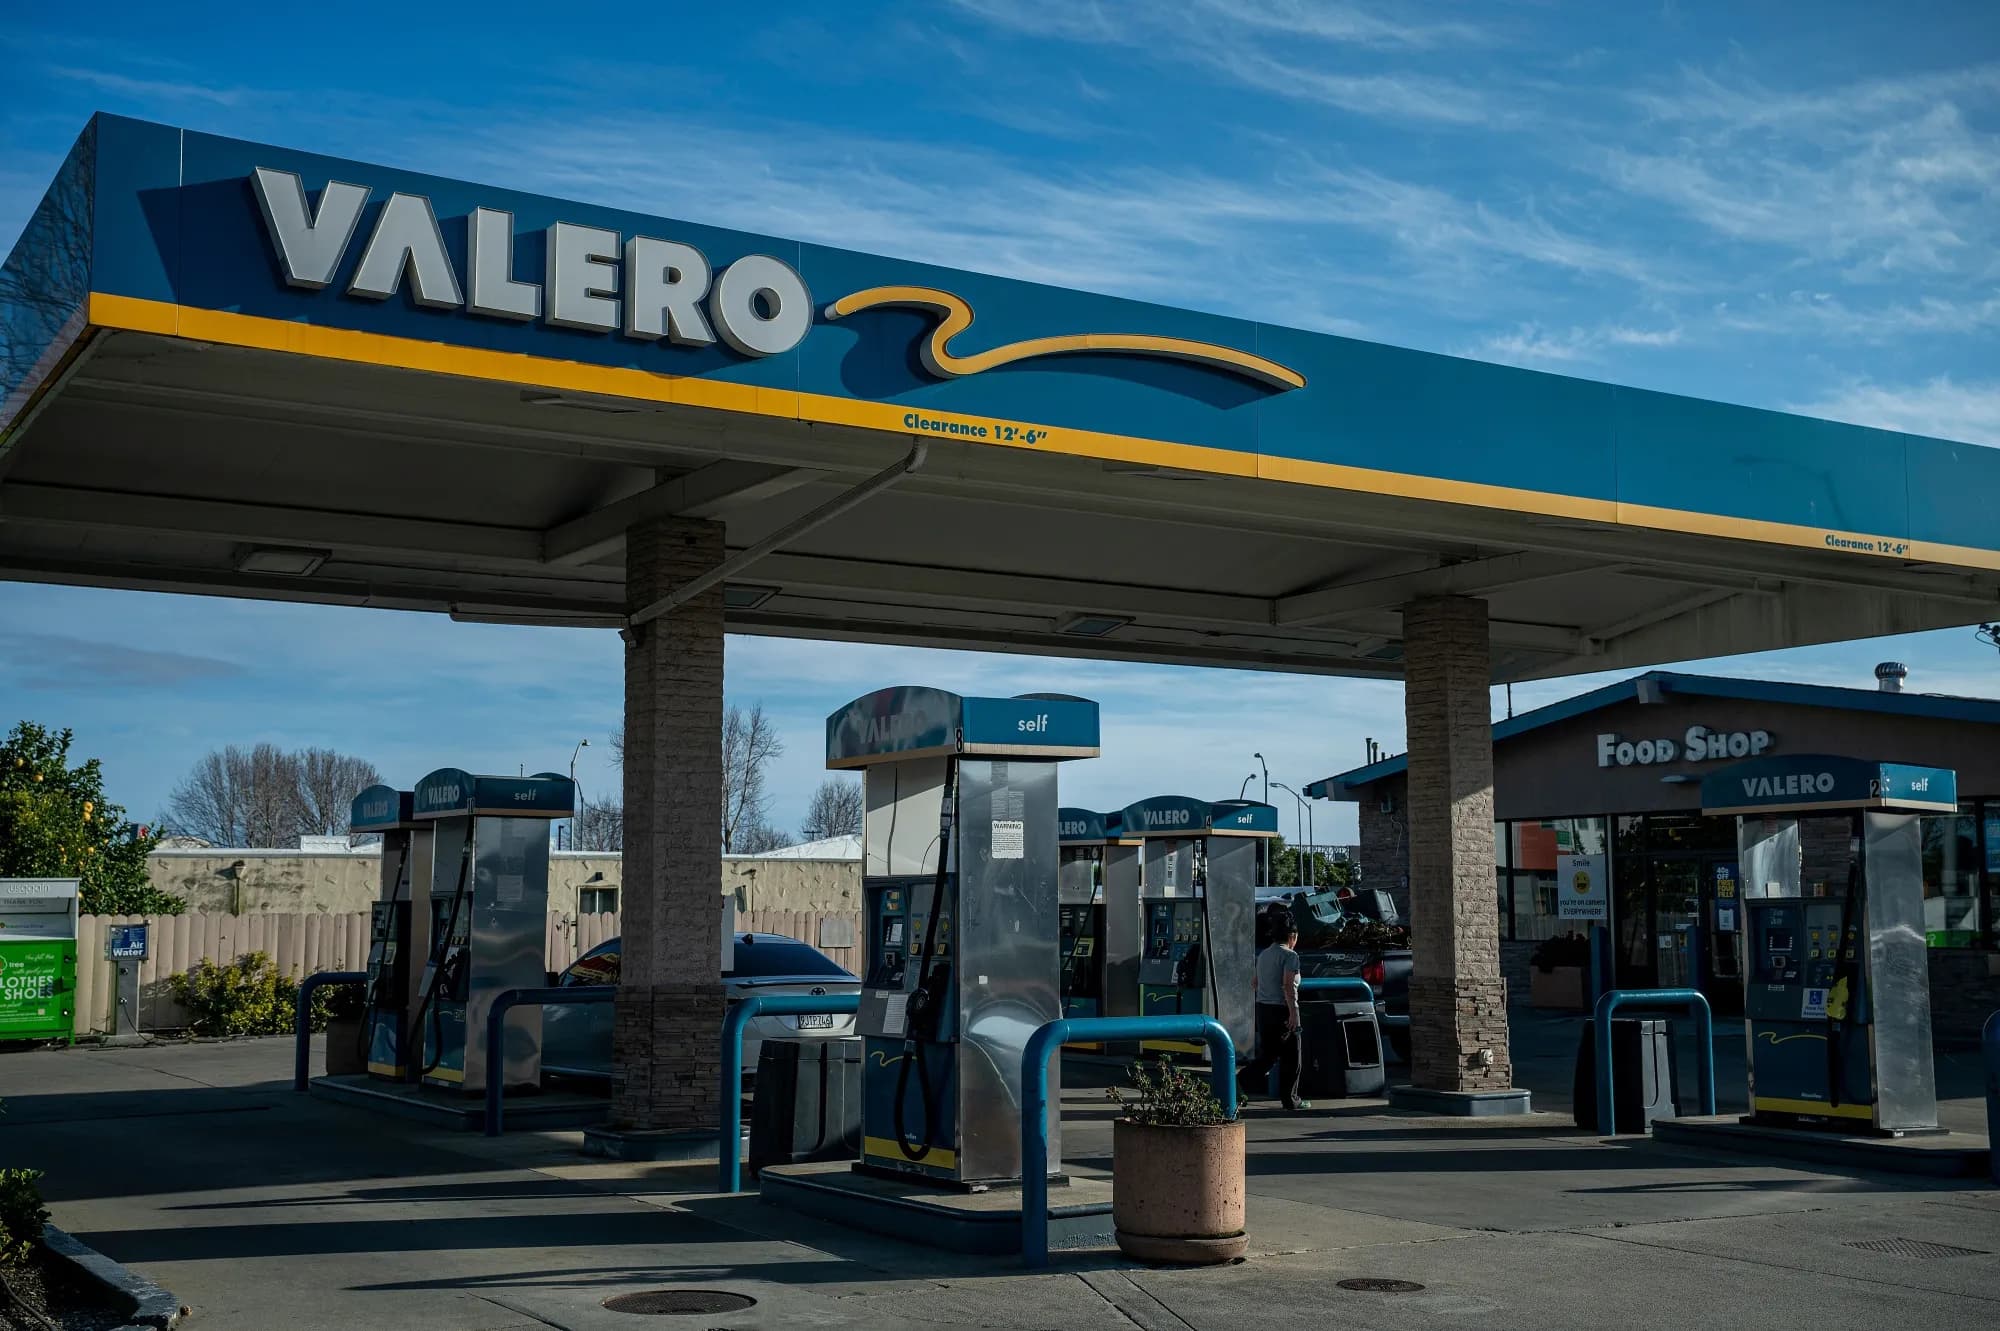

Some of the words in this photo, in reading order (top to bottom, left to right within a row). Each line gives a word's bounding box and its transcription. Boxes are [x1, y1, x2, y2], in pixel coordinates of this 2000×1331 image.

[249, 166, 813, 357] VALERO
[903, 413, 988, 437] Clearance
[1825, 534, 1873, 550] Clearance
[1017, 714, 1048, 732] self
[955, 728, 963, 752] 8
[1742, 772, 1835, 798] VALERO
[1871, 780, 1880, 799] 2
[1911, 778, 1928, 792] self
[428, 784, 460, 804] VALERO
[513, 788, 537, 801] self
[1143, 809, 1190, 825] VALERO
[1237, 814, 1253, 824] self
[1058, 820, 1087, 835] LERO
[1572, 858, 1590, 867] Smile
[1563, 908, 1601, 916] EVERYWHERE
[130, 941, 144, 949] Air
[113, 949, 144, 957] Water
[0, 975, 54, 988] LOTHES
[4, 987, 54, 1000] SHOES
